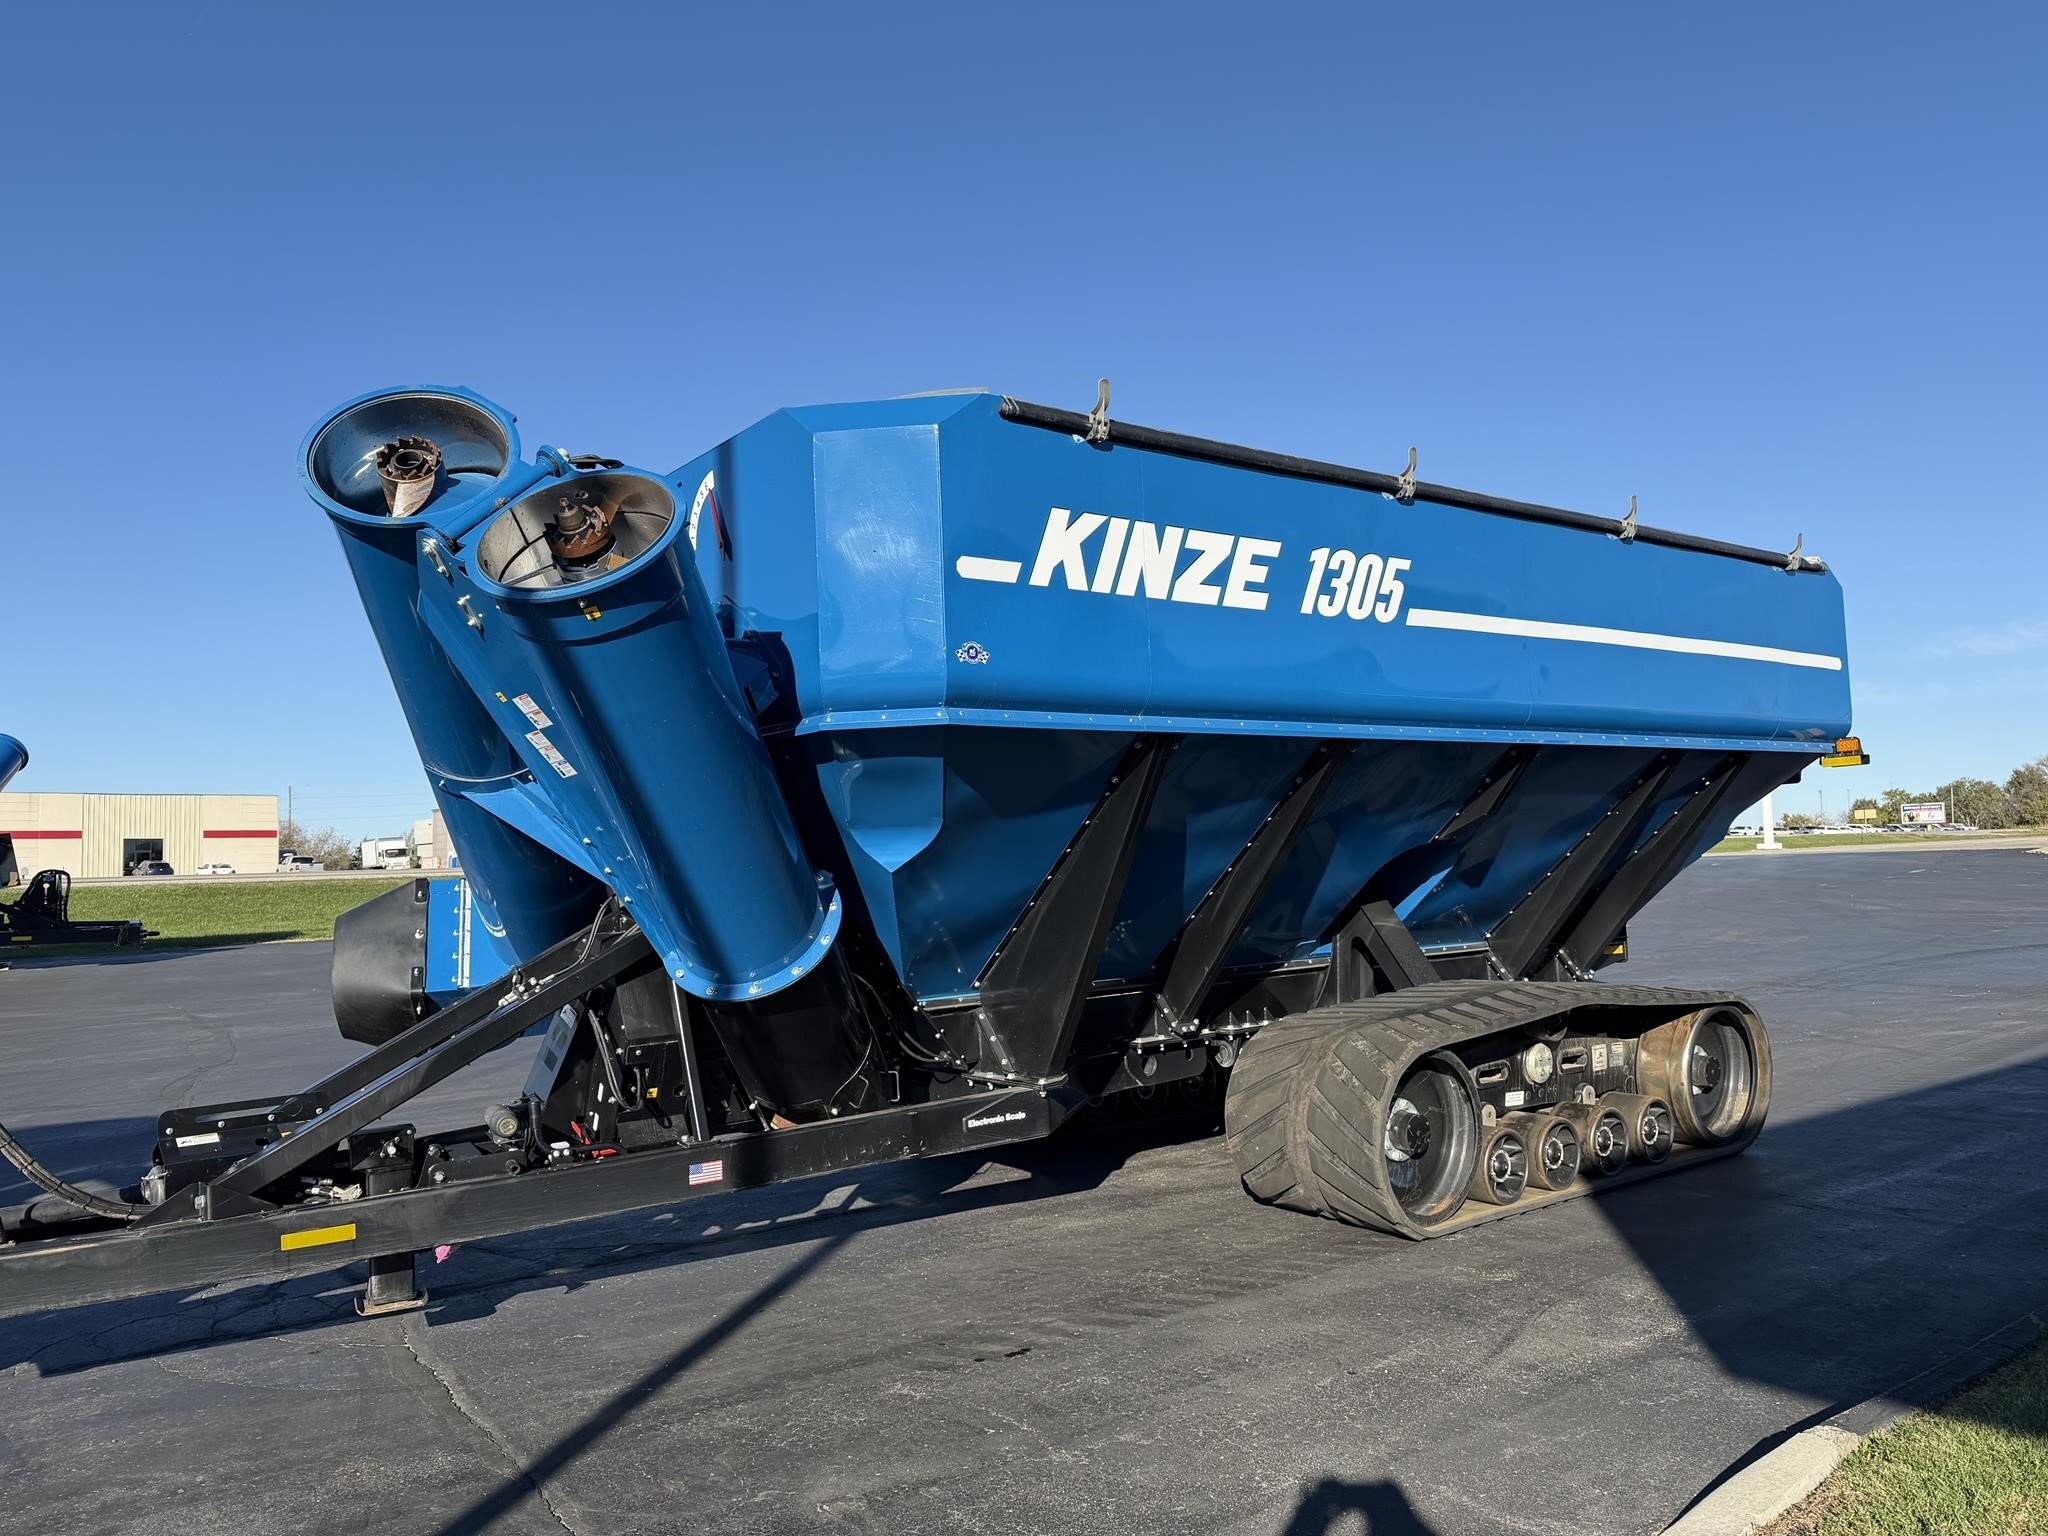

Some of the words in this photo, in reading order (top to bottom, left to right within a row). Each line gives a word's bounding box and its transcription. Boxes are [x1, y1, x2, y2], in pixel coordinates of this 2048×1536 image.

[1028, 506, 1282, 611] KINZE
[1300, 547, 1412, 623] 1305
[967, 1114, 1005, 1128] Electronic
[1005, 1111, 1026, 1121] Scale
